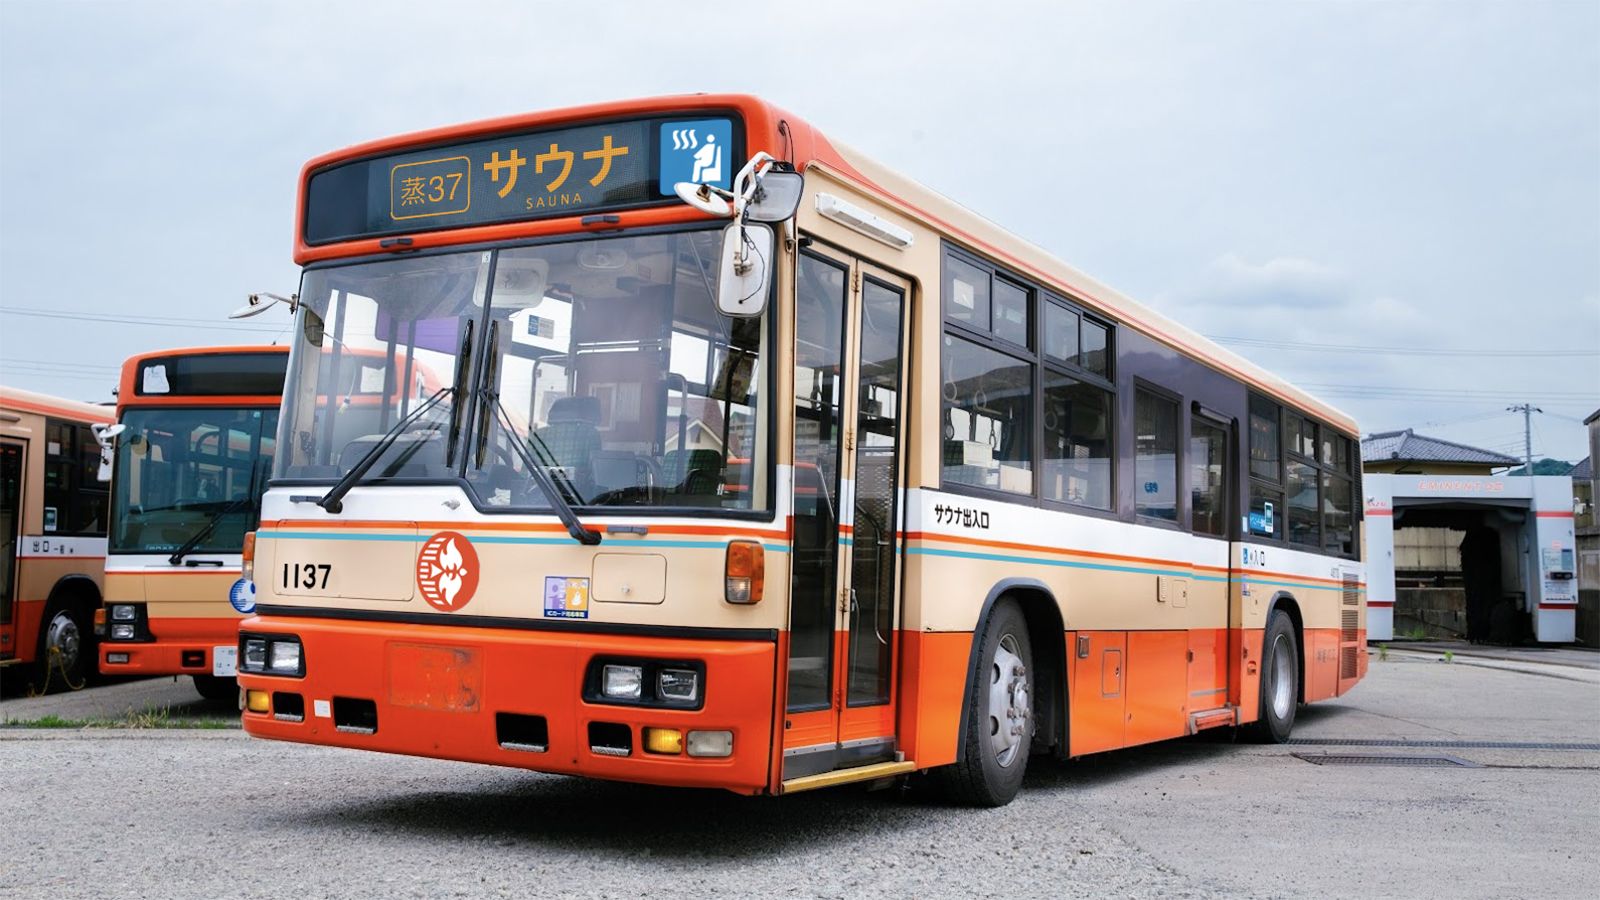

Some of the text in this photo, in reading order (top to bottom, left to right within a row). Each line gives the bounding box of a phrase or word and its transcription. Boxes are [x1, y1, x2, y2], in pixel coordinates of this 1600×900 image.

[483, 135, 629, 199] サウナ
[401, 173, 463, 207] 蒸37
[526, 193, 582, 210] SAUNA
[934, 504, 989, 529] サウナ出入口
[283, 563, 332, 590] 1137
